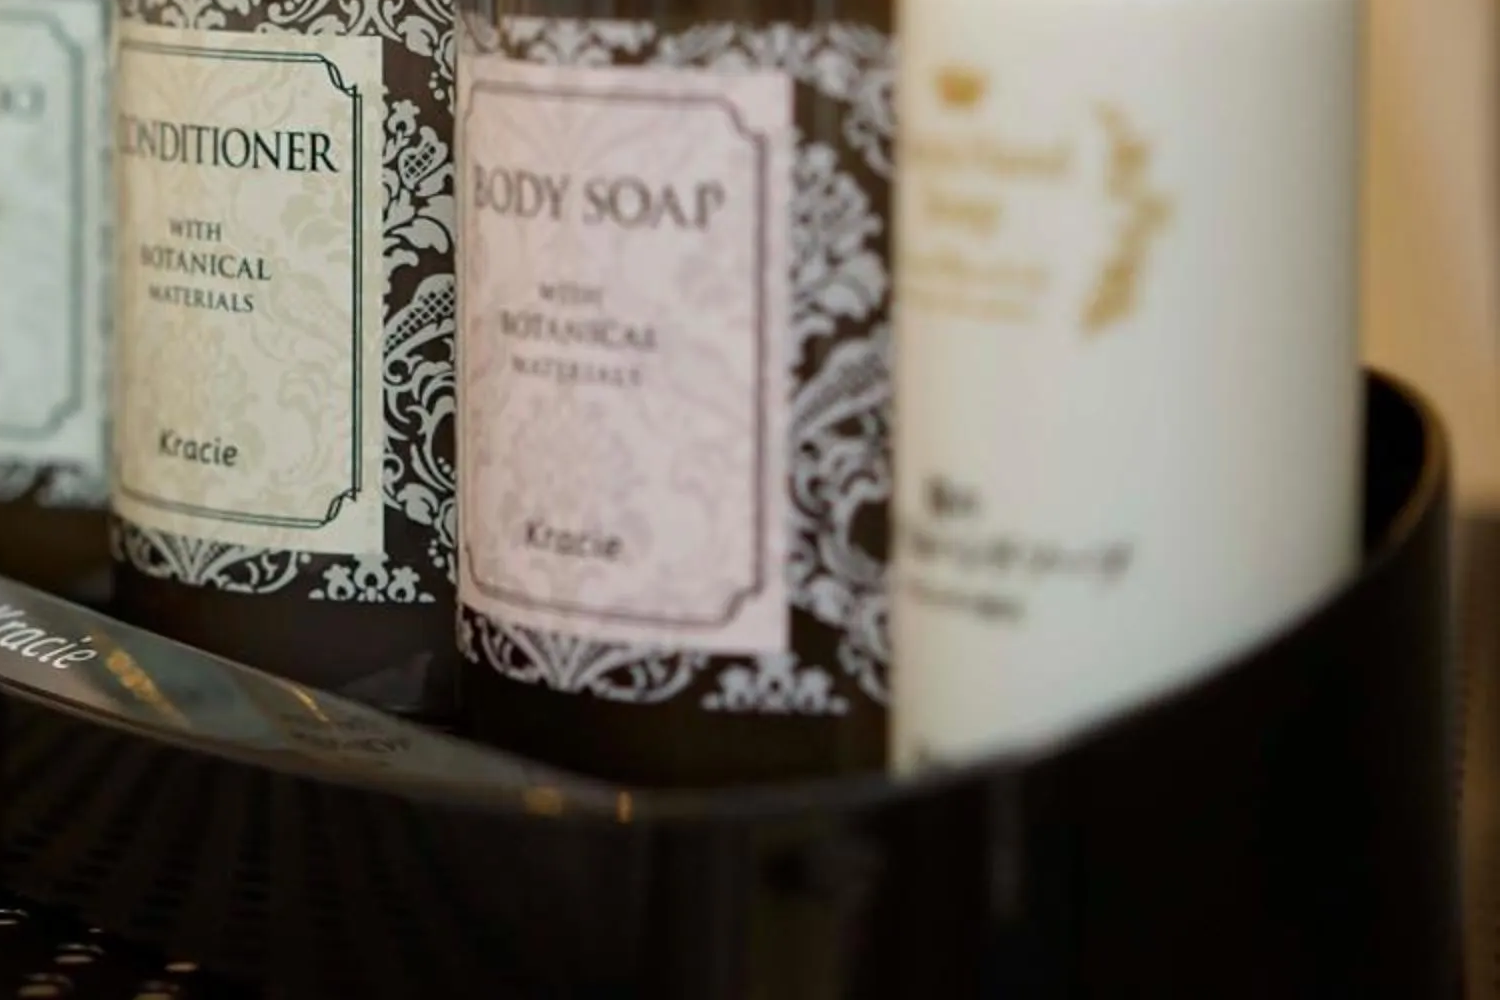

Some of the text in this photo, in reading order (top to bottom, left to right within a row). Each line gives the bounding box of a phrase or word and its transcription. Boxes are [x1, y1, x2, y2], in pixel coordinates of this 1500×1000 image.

[117, 114, 339, 172] ONDITIONER
[472, 165, 726, 232] BODY SOAP
[169, 218, 222, 243] WITH
[140, 246, 272, 281] BOTANICAL
[148, 284, 255, 313] MATERIALS
[160, 429, 238, 468] Kracie
